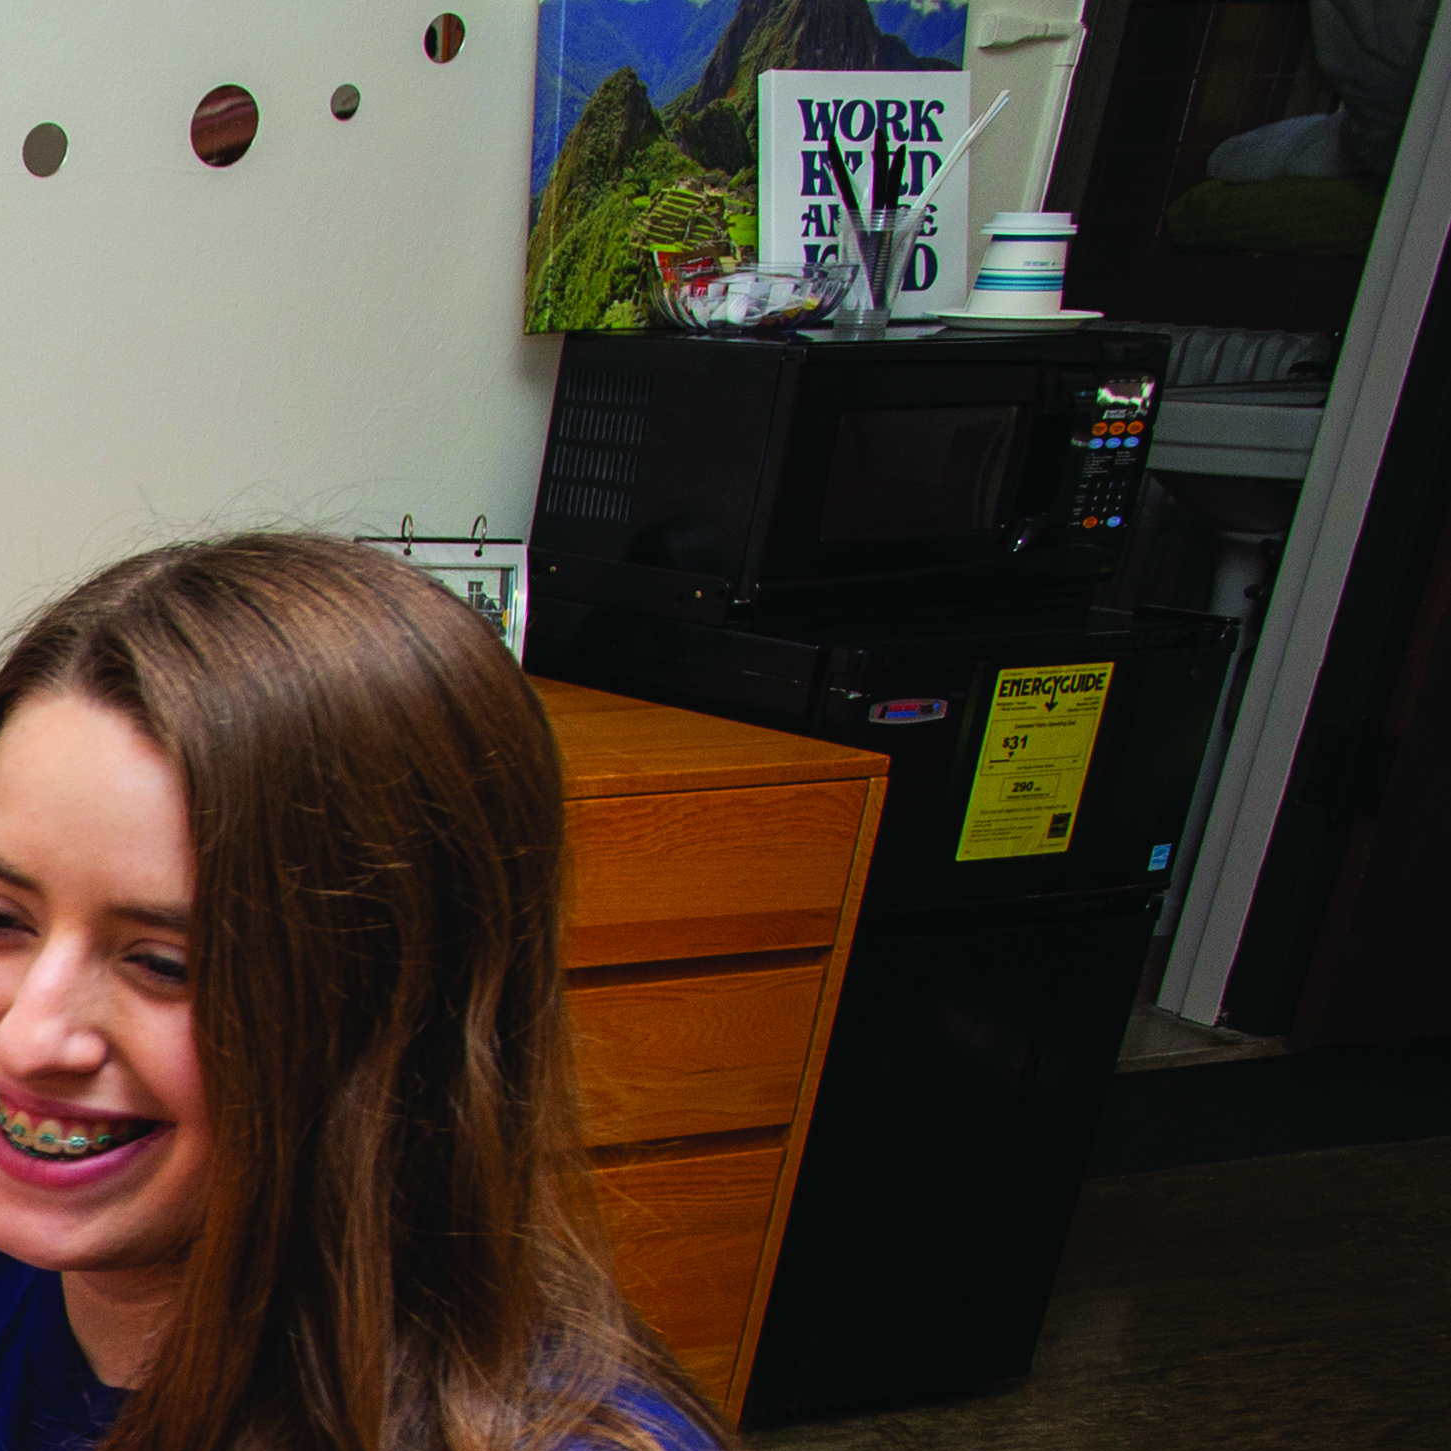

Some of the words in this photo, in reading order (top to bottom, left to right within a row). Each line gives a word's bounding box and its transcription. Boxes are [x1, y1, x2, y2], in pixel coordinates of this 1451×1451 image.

[797, 99, 945, 142] WORK
[1002, 734, 1029, 750] $31
[1012, 781, 1034, 793] 290
